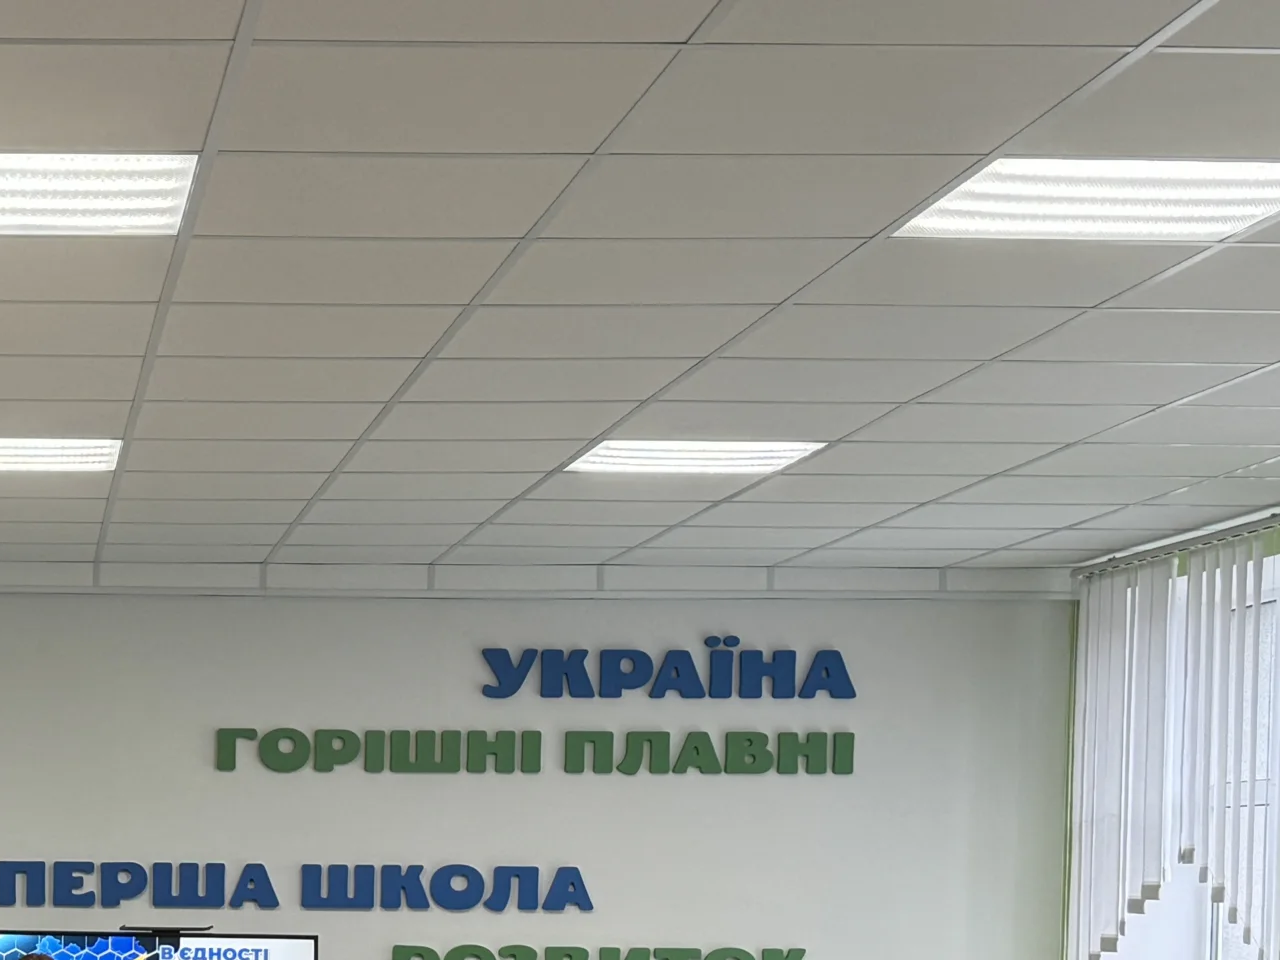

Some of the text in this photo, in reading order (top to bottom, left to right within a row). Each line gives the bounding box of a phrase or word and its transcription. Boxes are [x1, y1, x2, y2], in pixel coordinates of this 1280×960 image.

[481, 635, 856, 699] УКРАЇНА
[216, 727, 854, 774] ГОРІШНІ ПЛАВНІ
[301, 863, 593, 911] ШКОЛА
[161, 947, 173, 960] В
